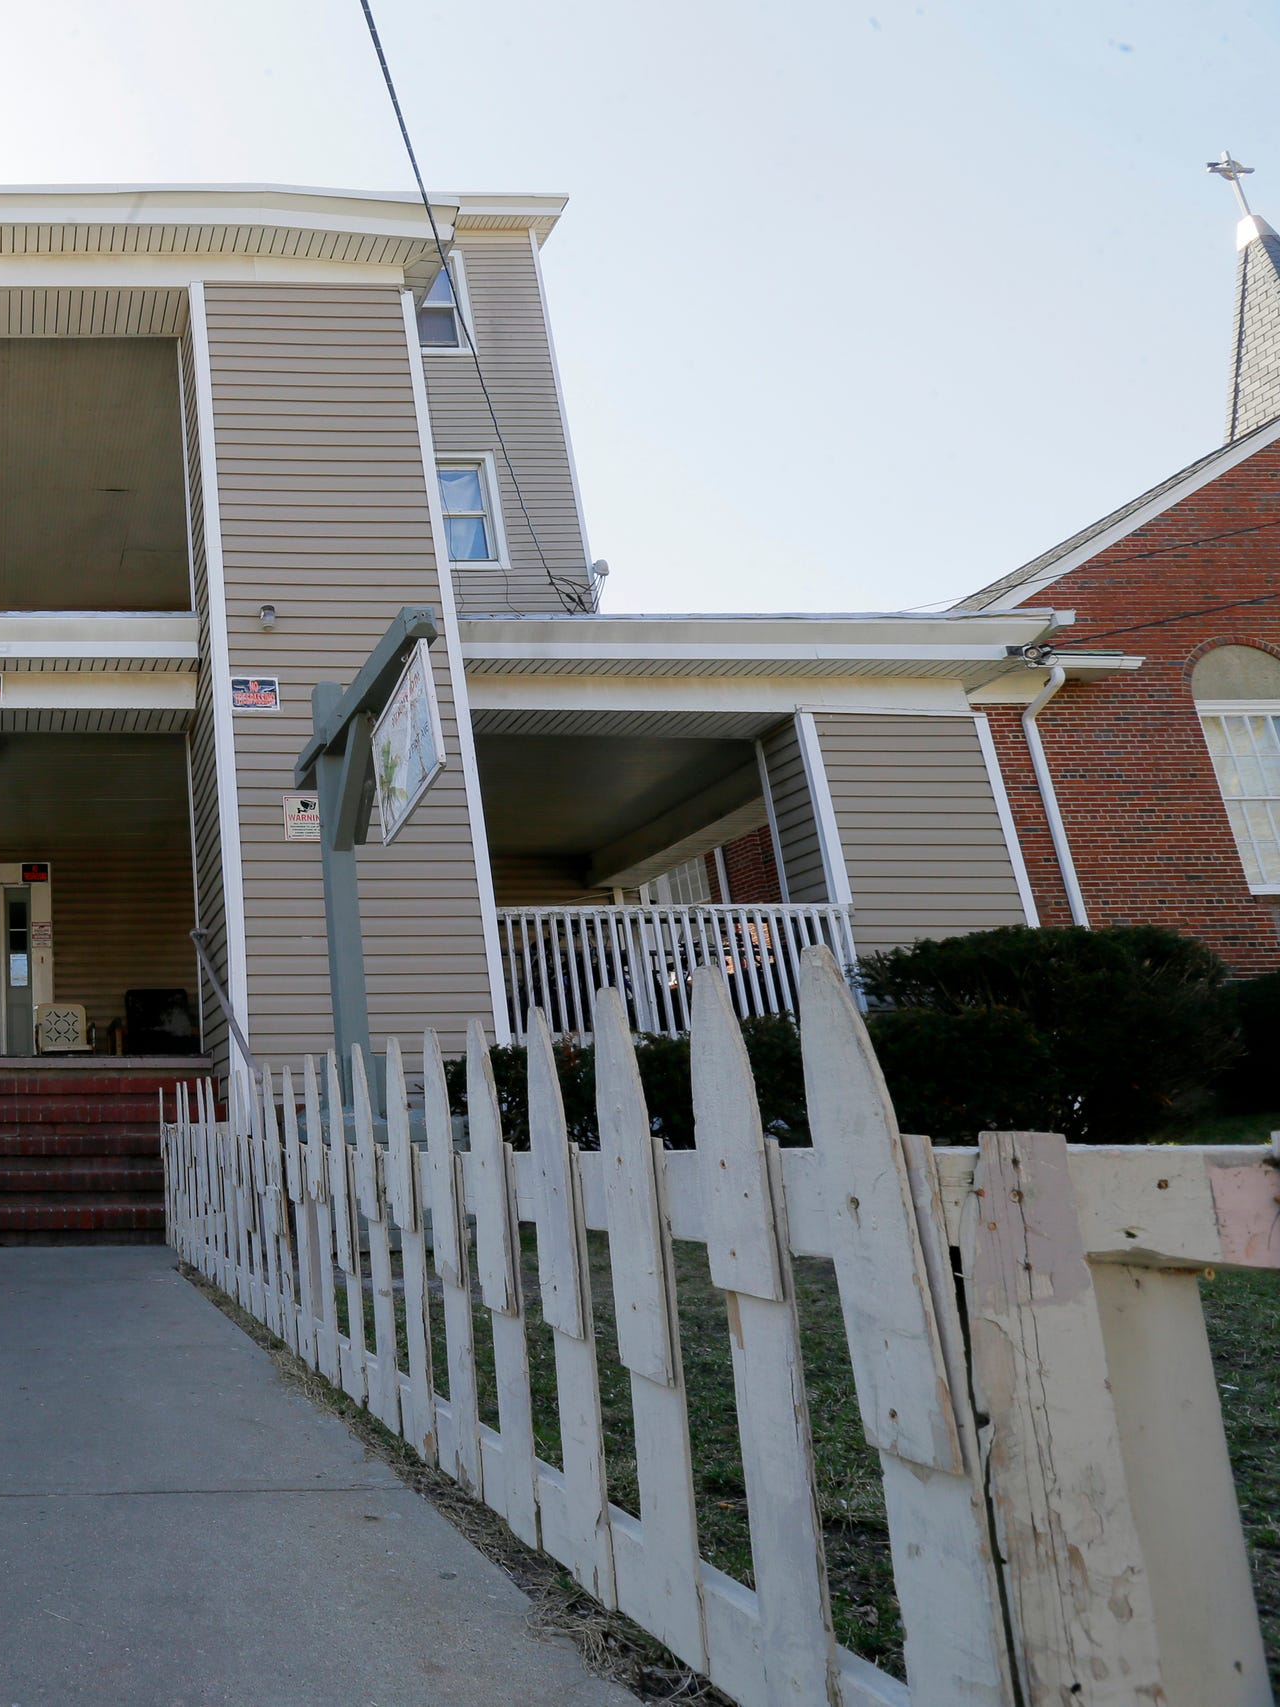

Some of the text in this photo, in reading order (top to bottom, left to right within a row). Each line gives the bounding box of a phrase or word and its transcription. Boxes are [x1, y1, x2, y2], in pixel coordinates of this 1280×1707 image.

[249, 681, 259, 692] NO
[234, 693, 275, 705] TRESPASSING
[288, 814, 320, 822] WARNIN
